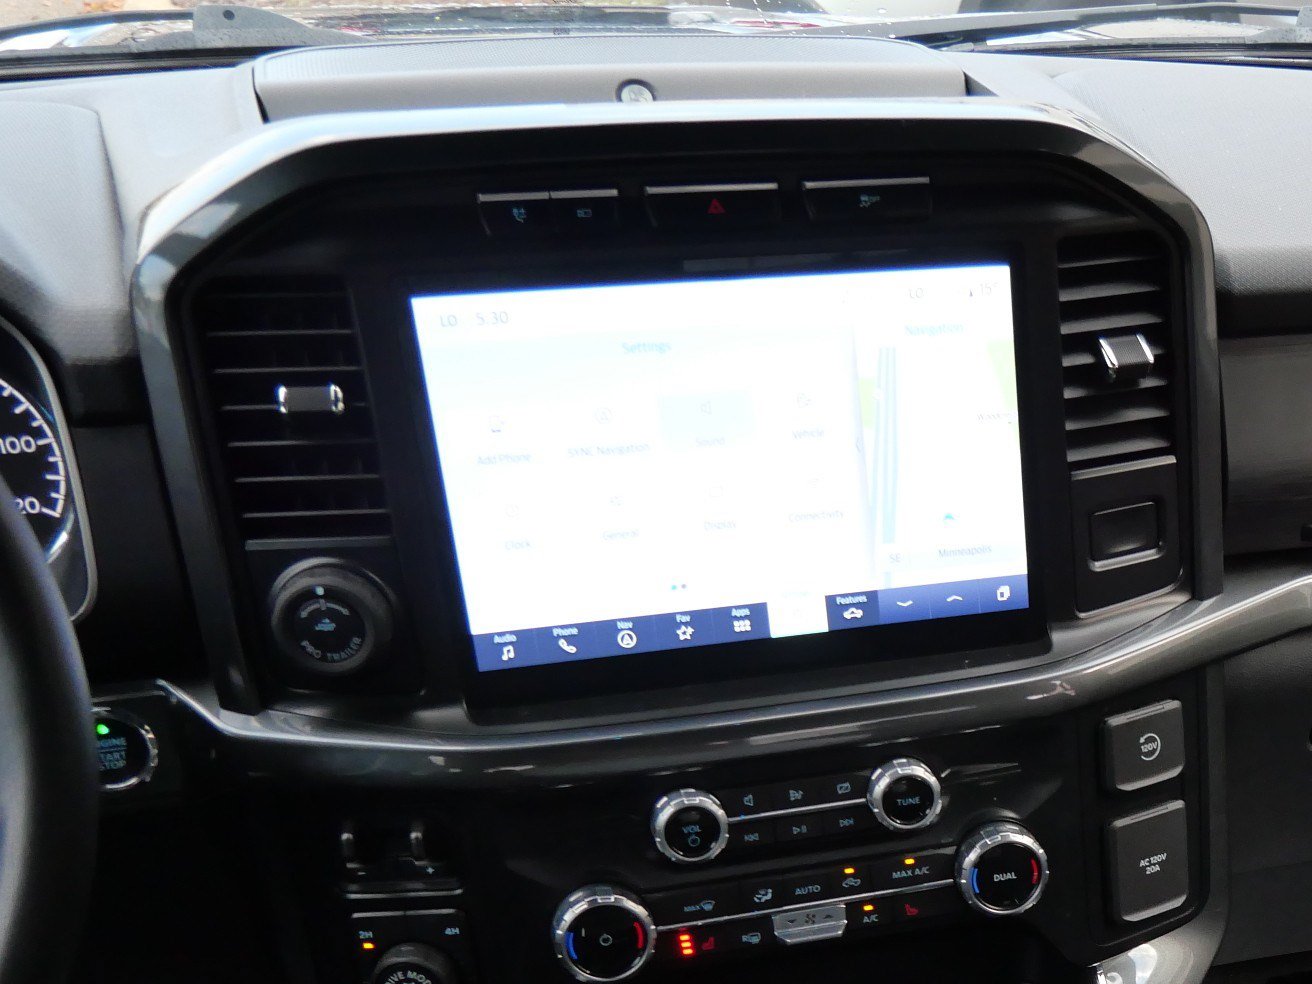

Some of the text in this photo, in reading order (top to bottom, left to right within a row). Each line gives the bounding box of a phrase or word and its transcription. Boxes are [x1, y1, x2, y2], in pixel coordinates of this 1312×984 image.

[937, 544, 993, 559] Minneapolis
[836, 595, 868, 605] Features
[675, 613, 691, 623] Fav
[731, 607, 751, 618] Apps
[617, 620, 634, 630] Nav
[553, 626, 579, 638] Phone
[493, 633, 518, 644] Audio
[1141, 741, 1158, 753] 120V
[897, 796, 921, 807] TUNE
[682, 824, 701, 833] VOL
[1139, 852, 1167, 868] AC 120V
[892, 866, 930, 880] MAX A/C
[1145, 864, 1160, 875] 20A
[993, 871, 1017, 882] DUAL
[794, 885, 821, 895] AUTO
[862, 914, 879, 923] A/C
